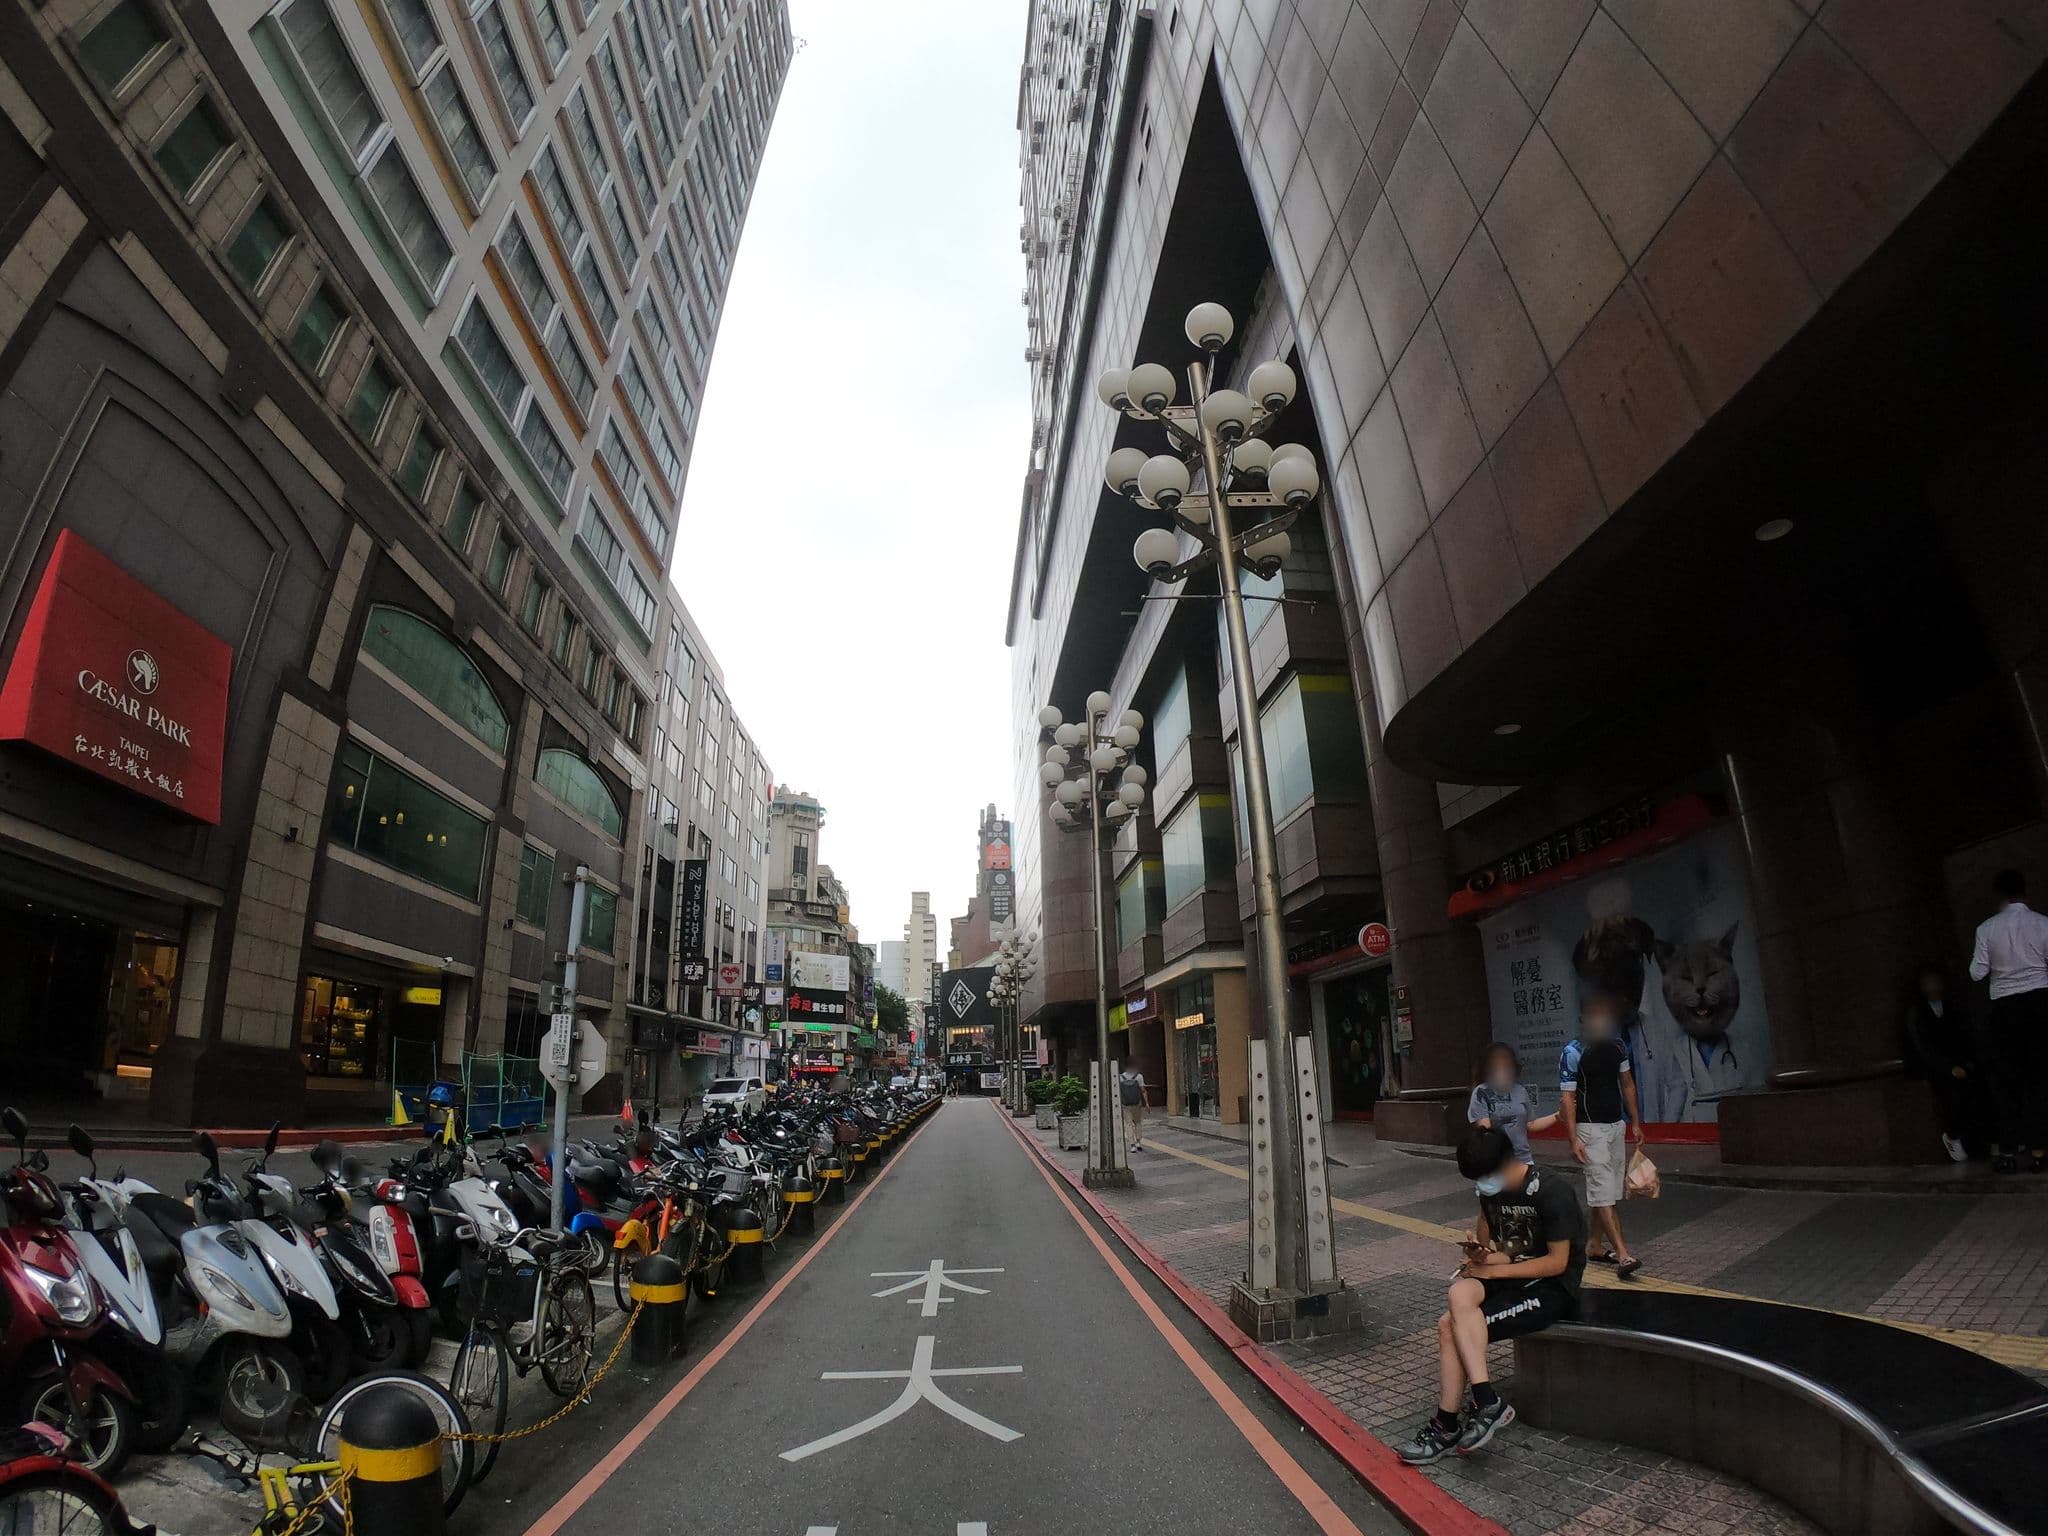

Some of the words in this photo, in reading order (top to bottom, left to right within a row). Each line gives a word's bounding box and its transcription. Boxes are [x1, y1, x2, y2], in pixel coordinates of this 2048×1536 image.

[146, 705, 193, 748] PARK
[118, 736, 149, 761] TAIPEI
[690, 921, 699, 948] HOTEL
[1367, 934, 1386, 945] ATM
[1513, 982, 1564, 1017] 醫務室
